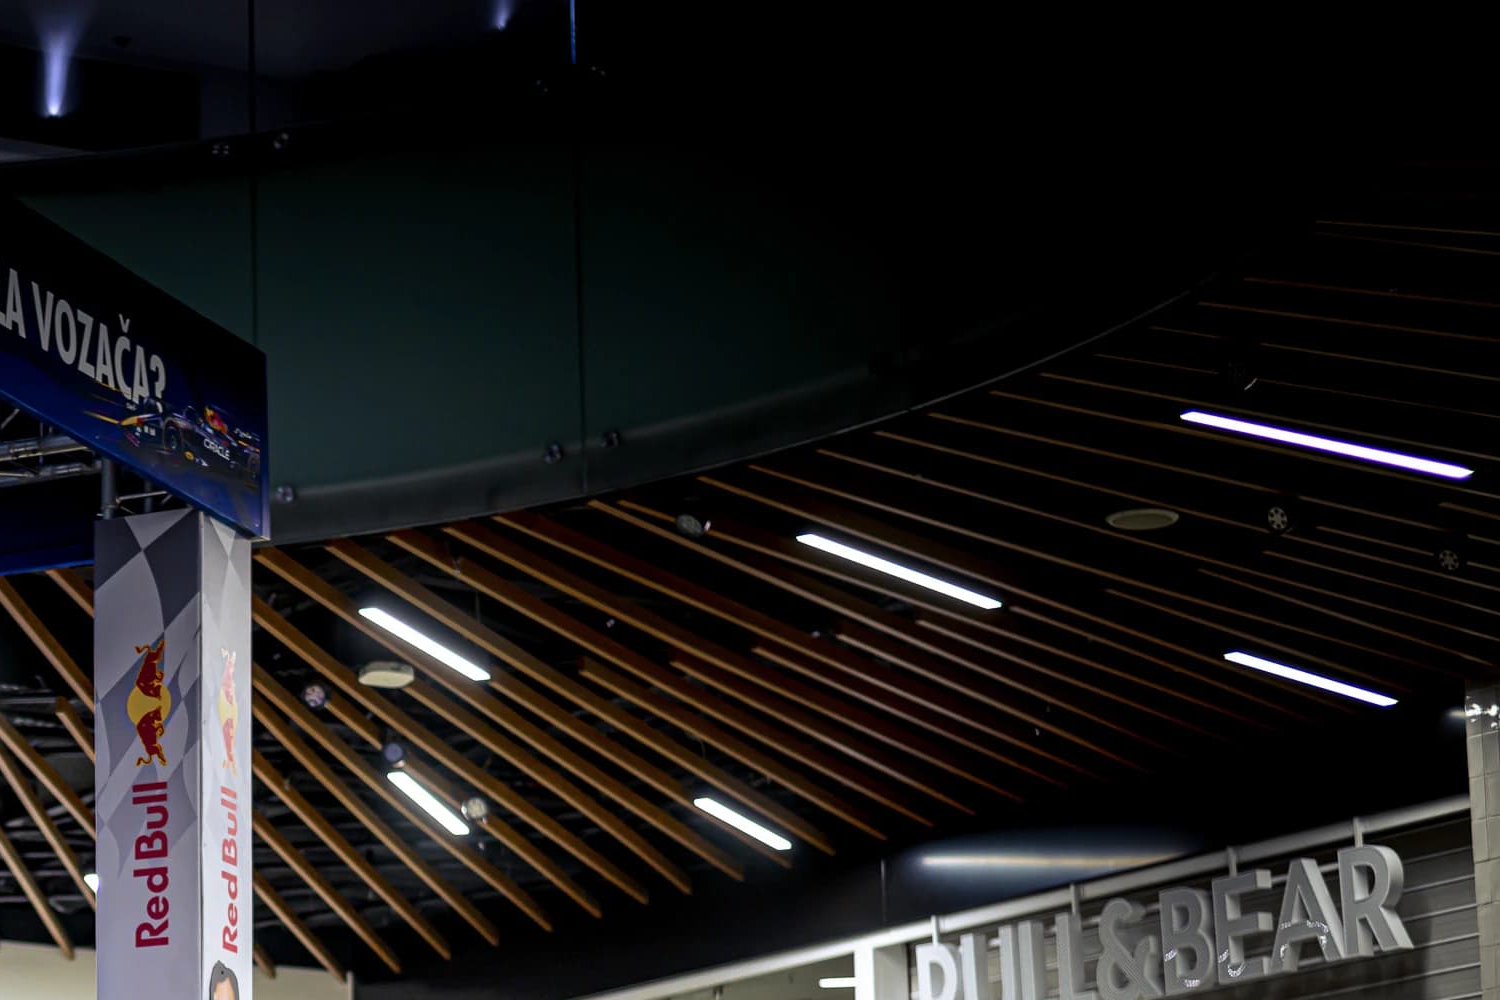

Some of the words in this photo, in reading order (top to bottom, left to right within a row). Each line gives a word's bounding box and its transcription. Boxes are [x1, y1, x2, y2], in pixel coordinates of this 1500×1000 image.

[31, 281, 167, 415] VOZAČA?
[132, 781, 169, 860] Bull
[220, 787, 239, 867] Bull
[133, 867, 169, 947] Red
[221, 870, 239, 954] Red
